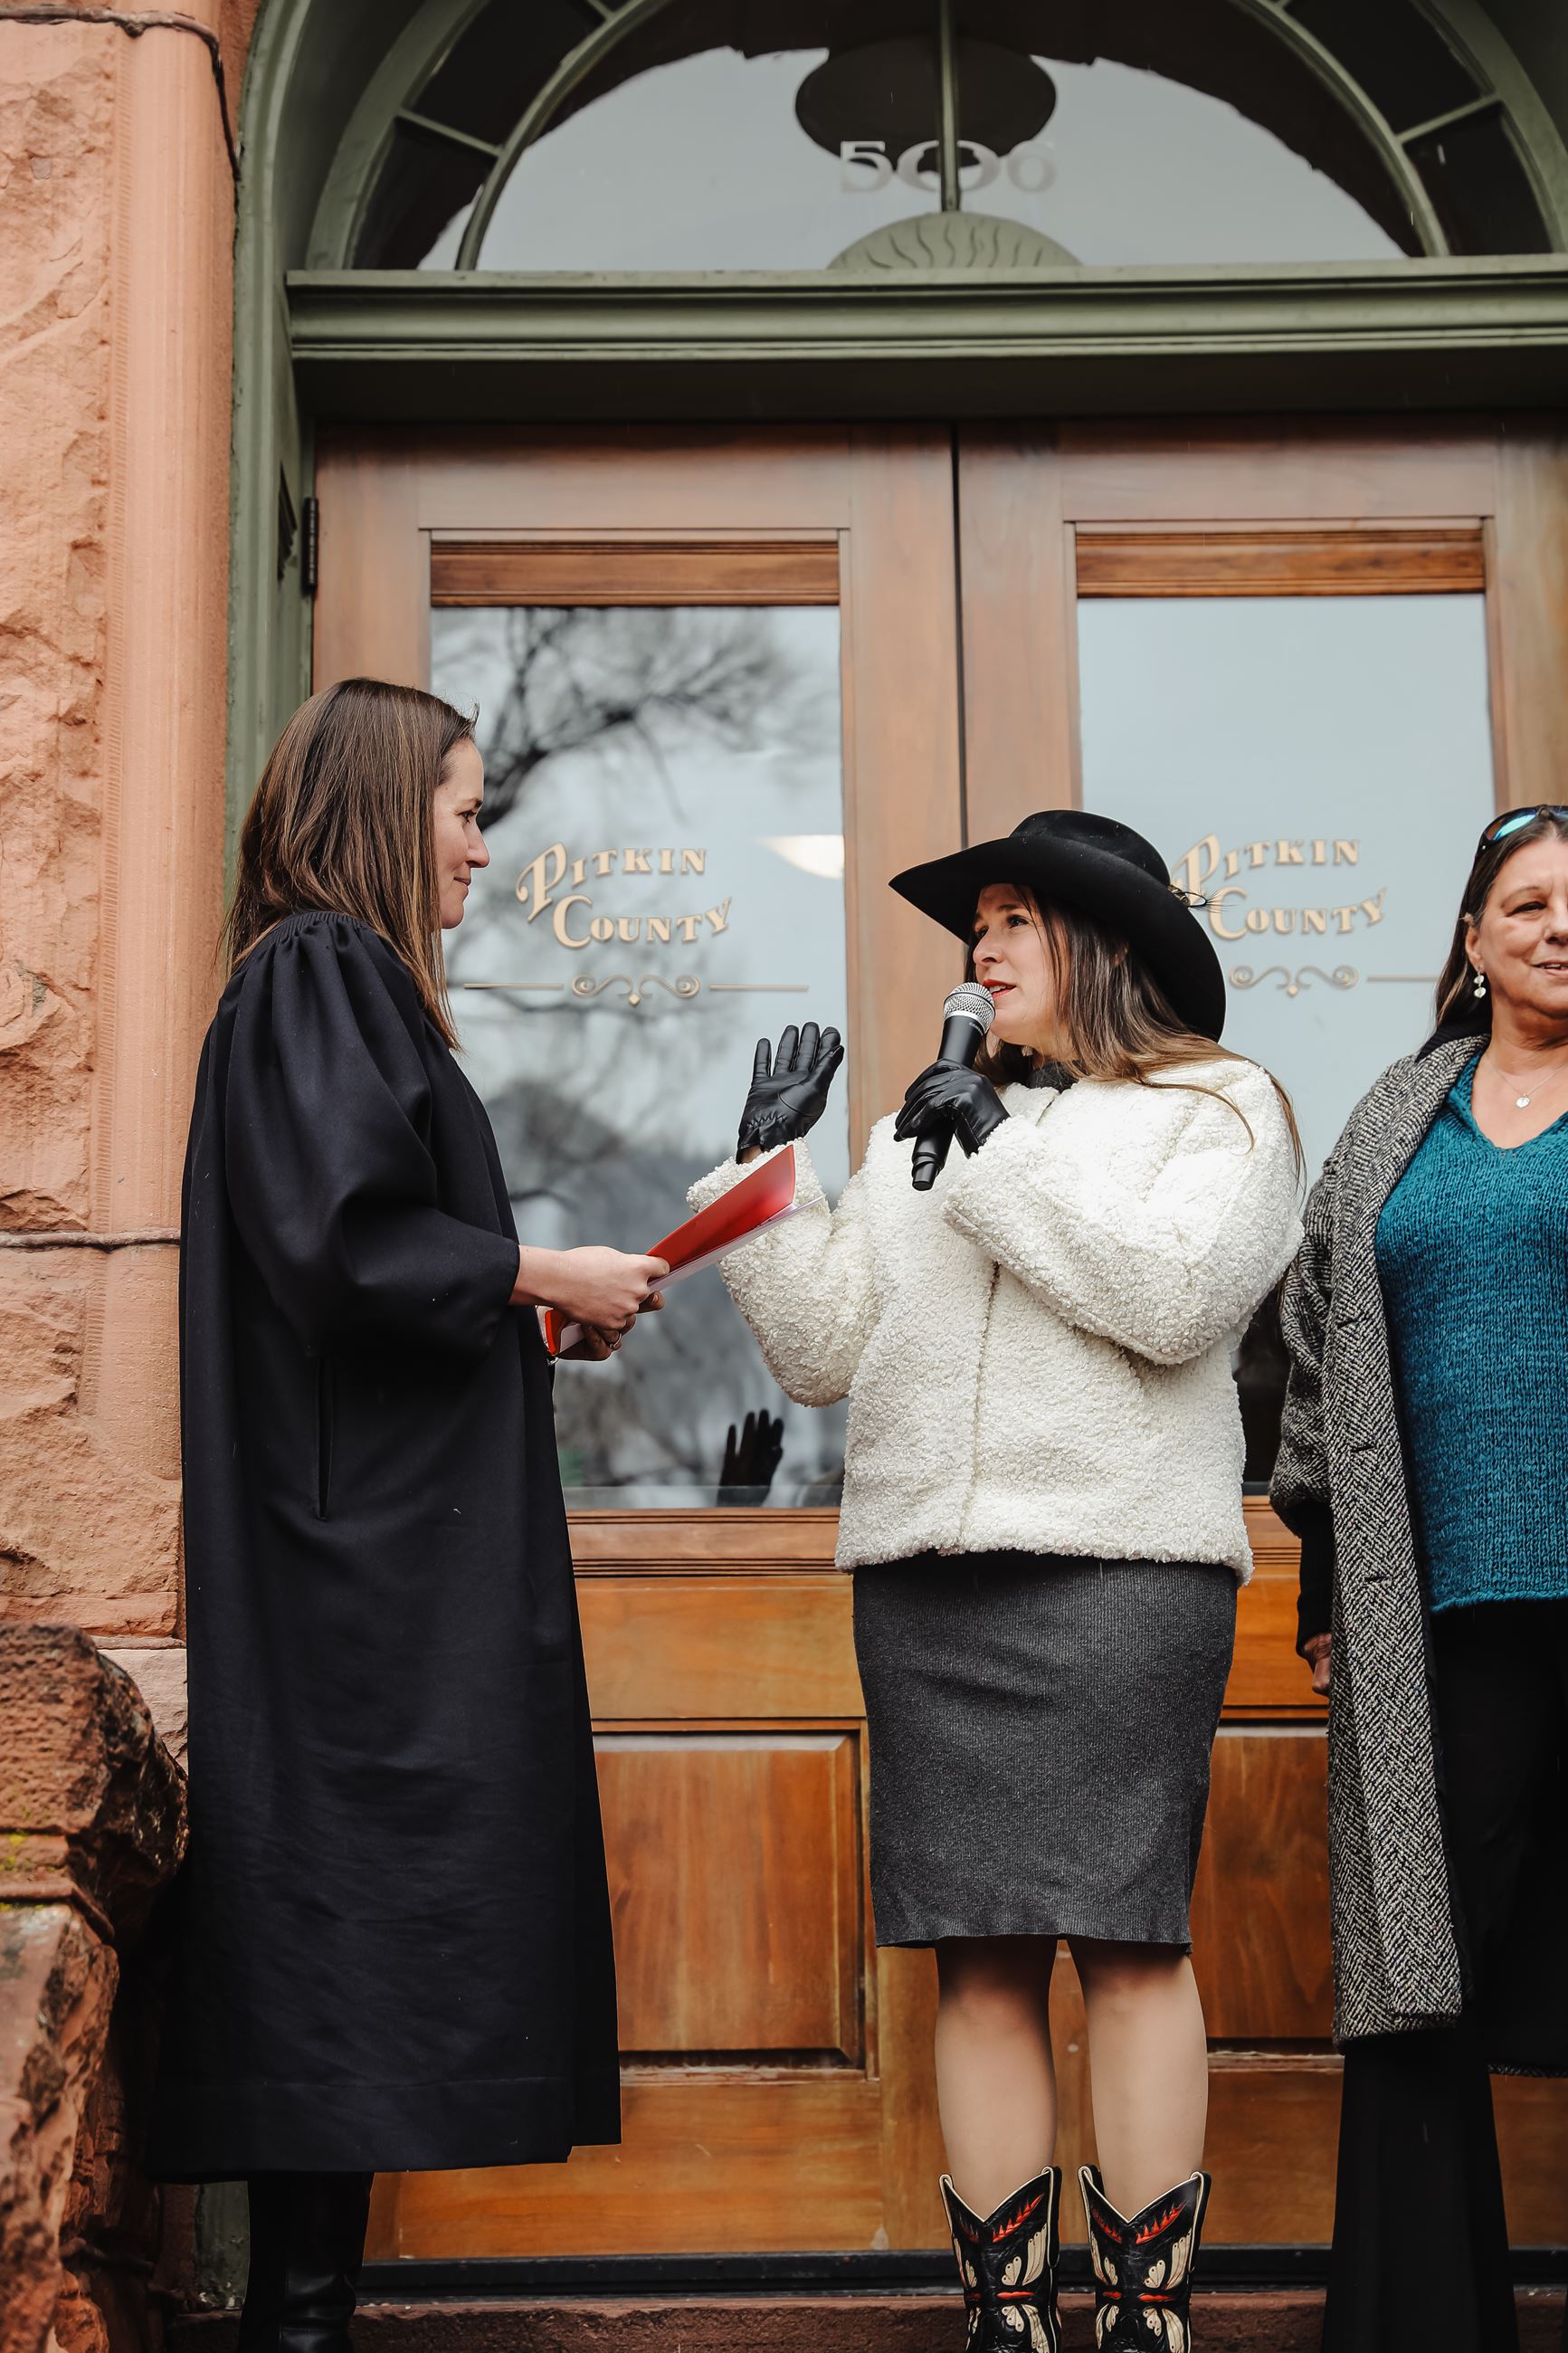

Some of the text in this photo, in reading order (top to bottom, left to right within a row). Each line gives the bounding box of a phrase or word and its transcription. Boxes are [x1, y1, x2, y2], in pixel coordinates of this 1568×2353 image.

[515, 842, 708, 923] PITKIN
[1170, 833, 1361, 907] PITKIN
[552, 894, 733, 949] COUNTY
[1208, 885, 1387, 941] COUNTY
